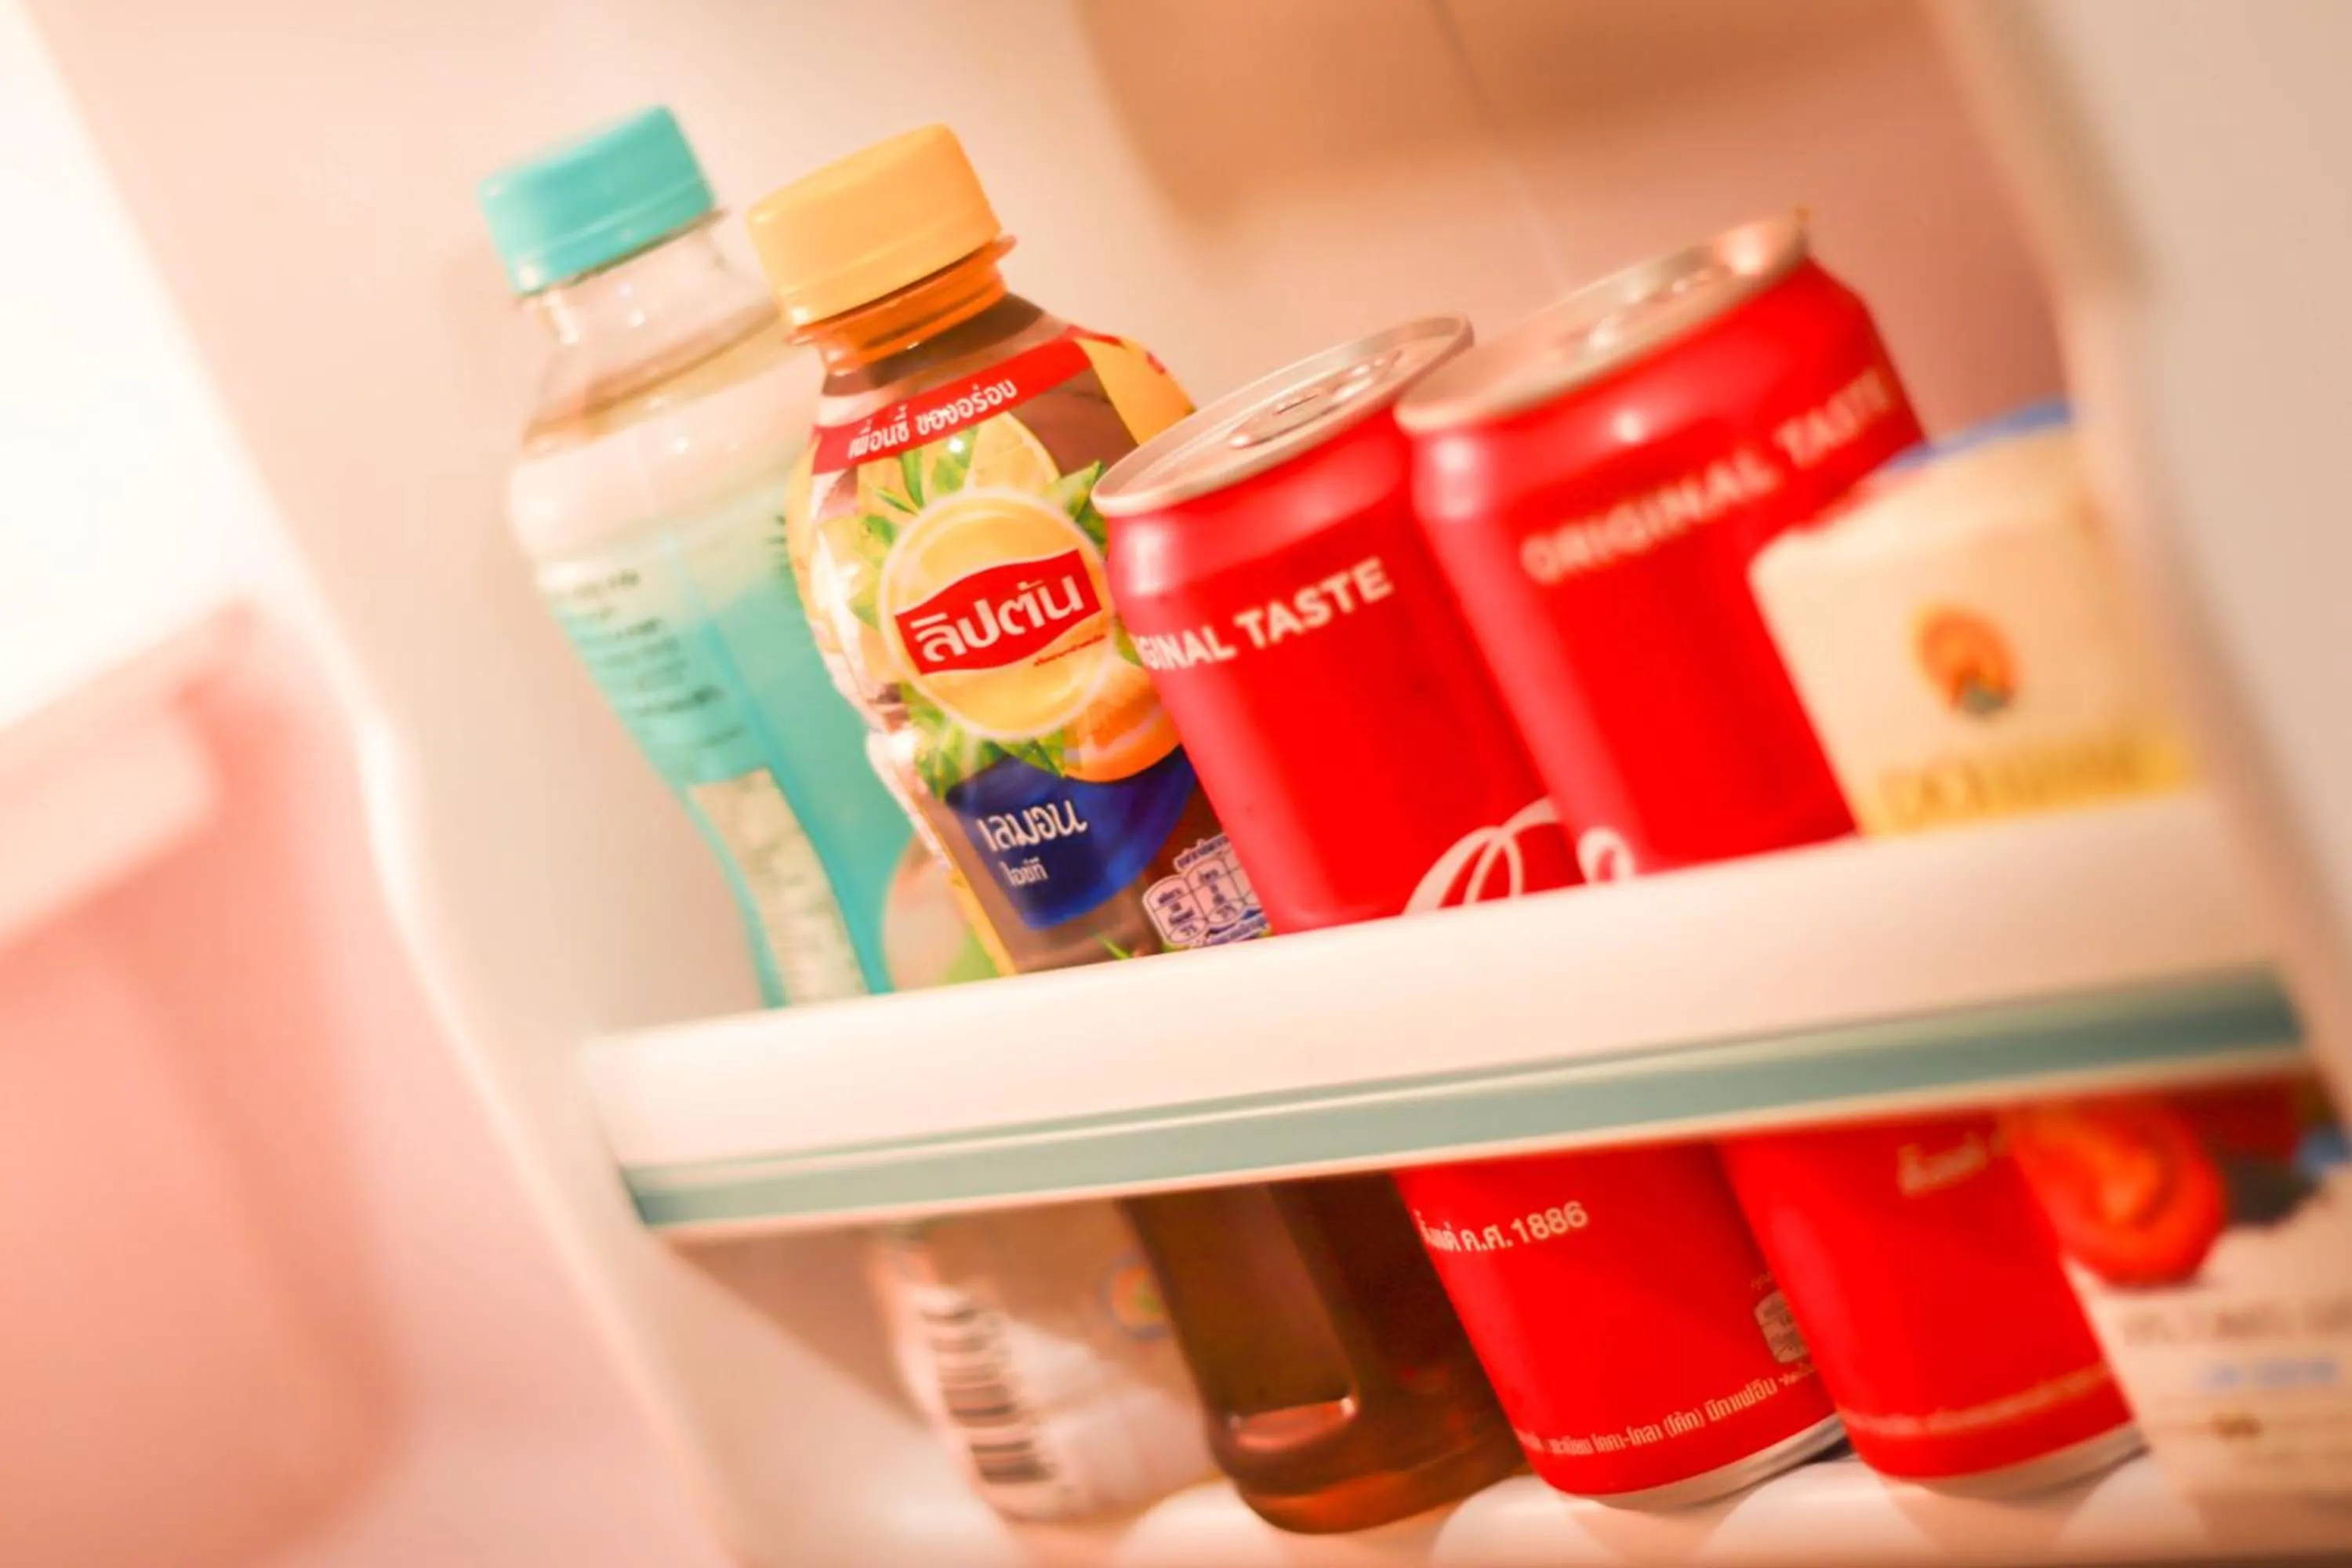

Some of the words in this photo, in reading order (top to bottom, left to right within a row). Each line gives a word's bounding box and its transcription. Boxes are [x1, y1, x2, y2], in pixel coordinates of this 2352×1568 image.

[1520, 452, 1781, 585] ORIGINAL
[910, 575, 1085, 662] ลิปตัน
[1132, 626, 1237, 670] GINAL
[1233, 557, 1395, 651] TASTE
[975, 799, 1088, 852] เลมอน
[1510, 1200, 1589, 1250] 1886
